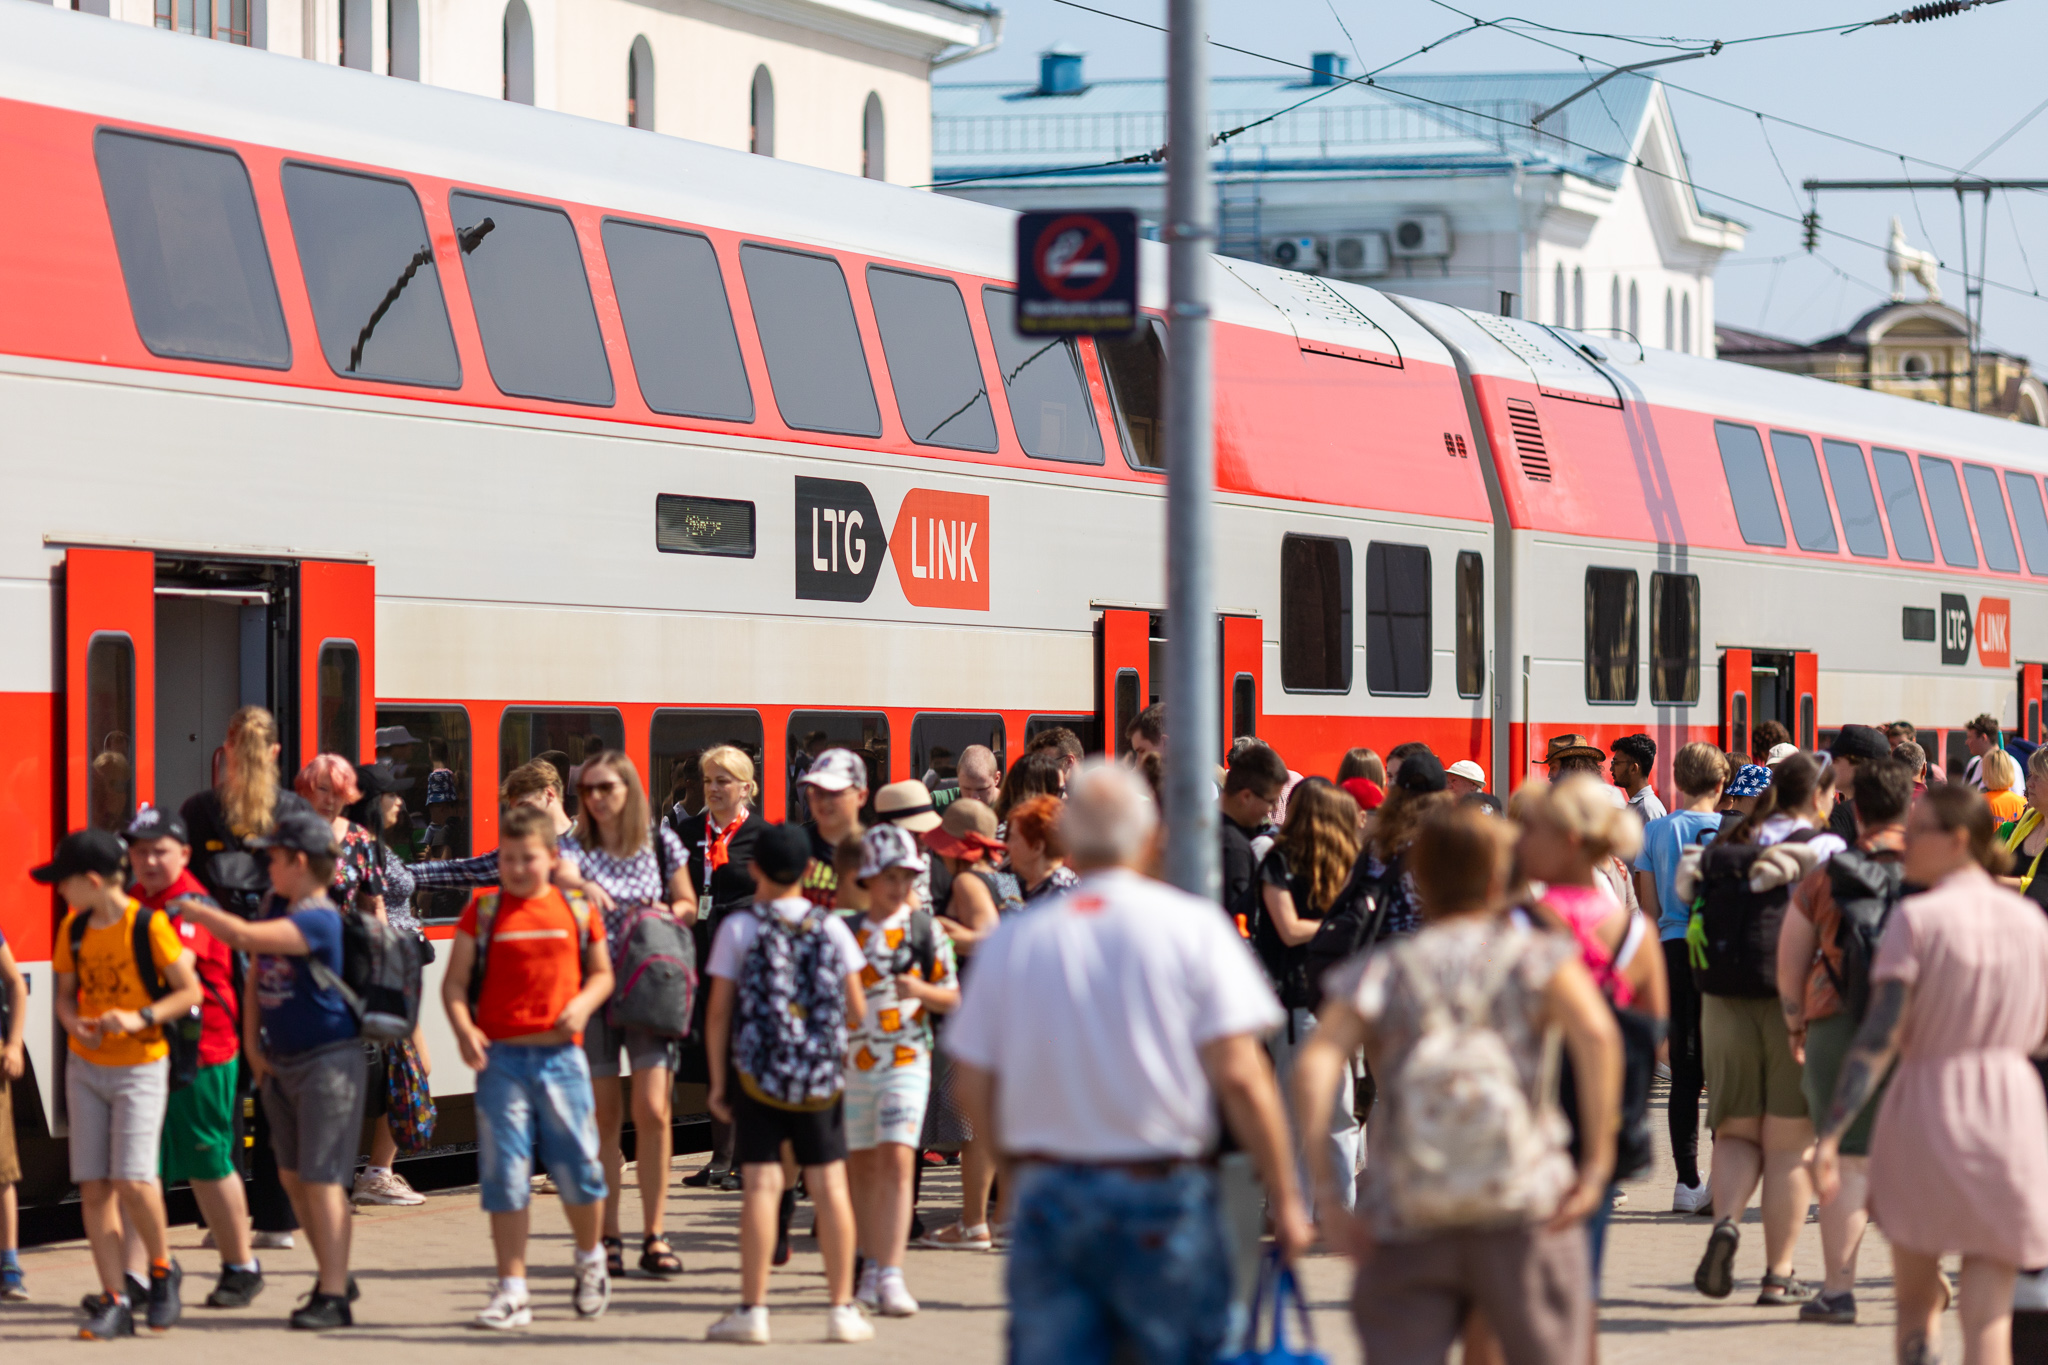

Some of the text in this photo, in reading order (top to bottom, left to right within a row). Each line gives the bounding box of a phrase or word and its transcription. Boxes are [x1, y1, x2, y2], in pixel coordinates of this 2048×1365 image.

[812, 507, 979, 583] LTG LINK
[1946, 608, 2007, 653] LTG LINK
